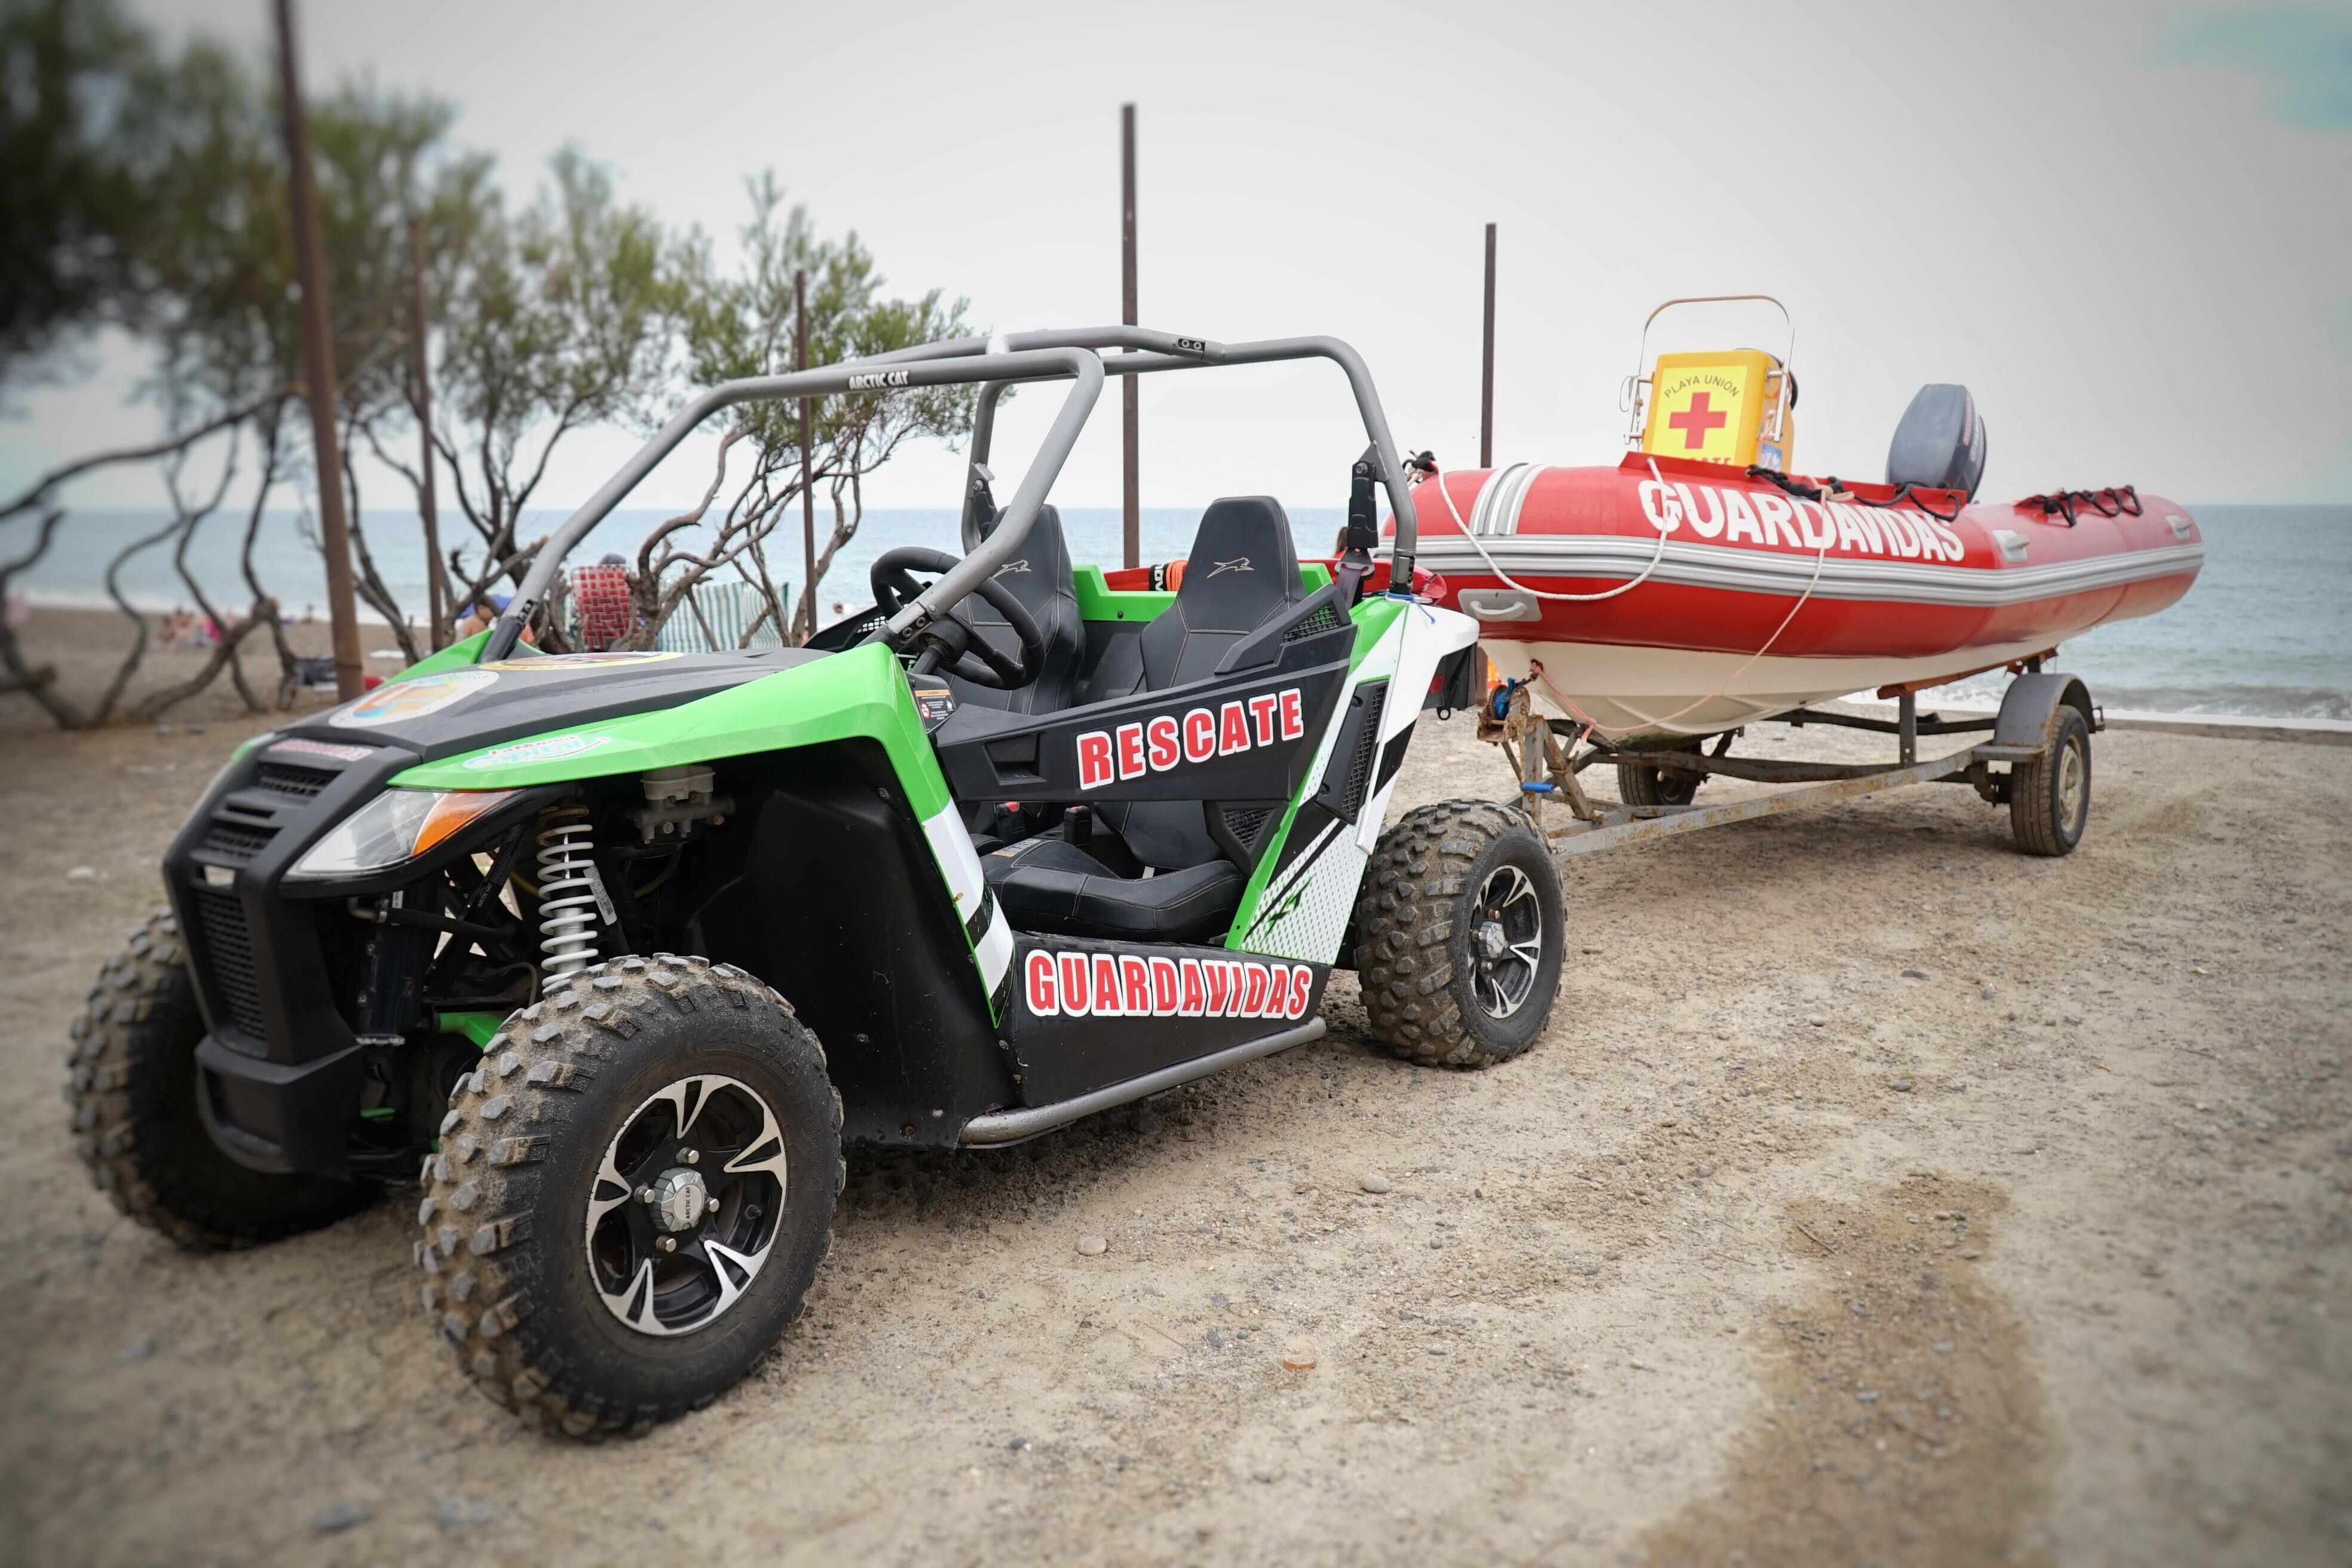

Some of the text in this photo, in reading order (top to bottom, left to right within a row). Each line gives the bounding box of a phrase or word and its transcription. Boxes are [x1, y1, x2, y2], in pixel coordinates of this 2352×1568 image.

[849, 370, 908, 390] ARCTIC CAT
[1664, 375, 1700, 398] PLAYA
[1638, 480, 1964, 562] GUARDAVIDAS
[1076, 688, 1304, 790] RESCATE
[1025, 949, 1313, 1019] GUARDAVIDAS
